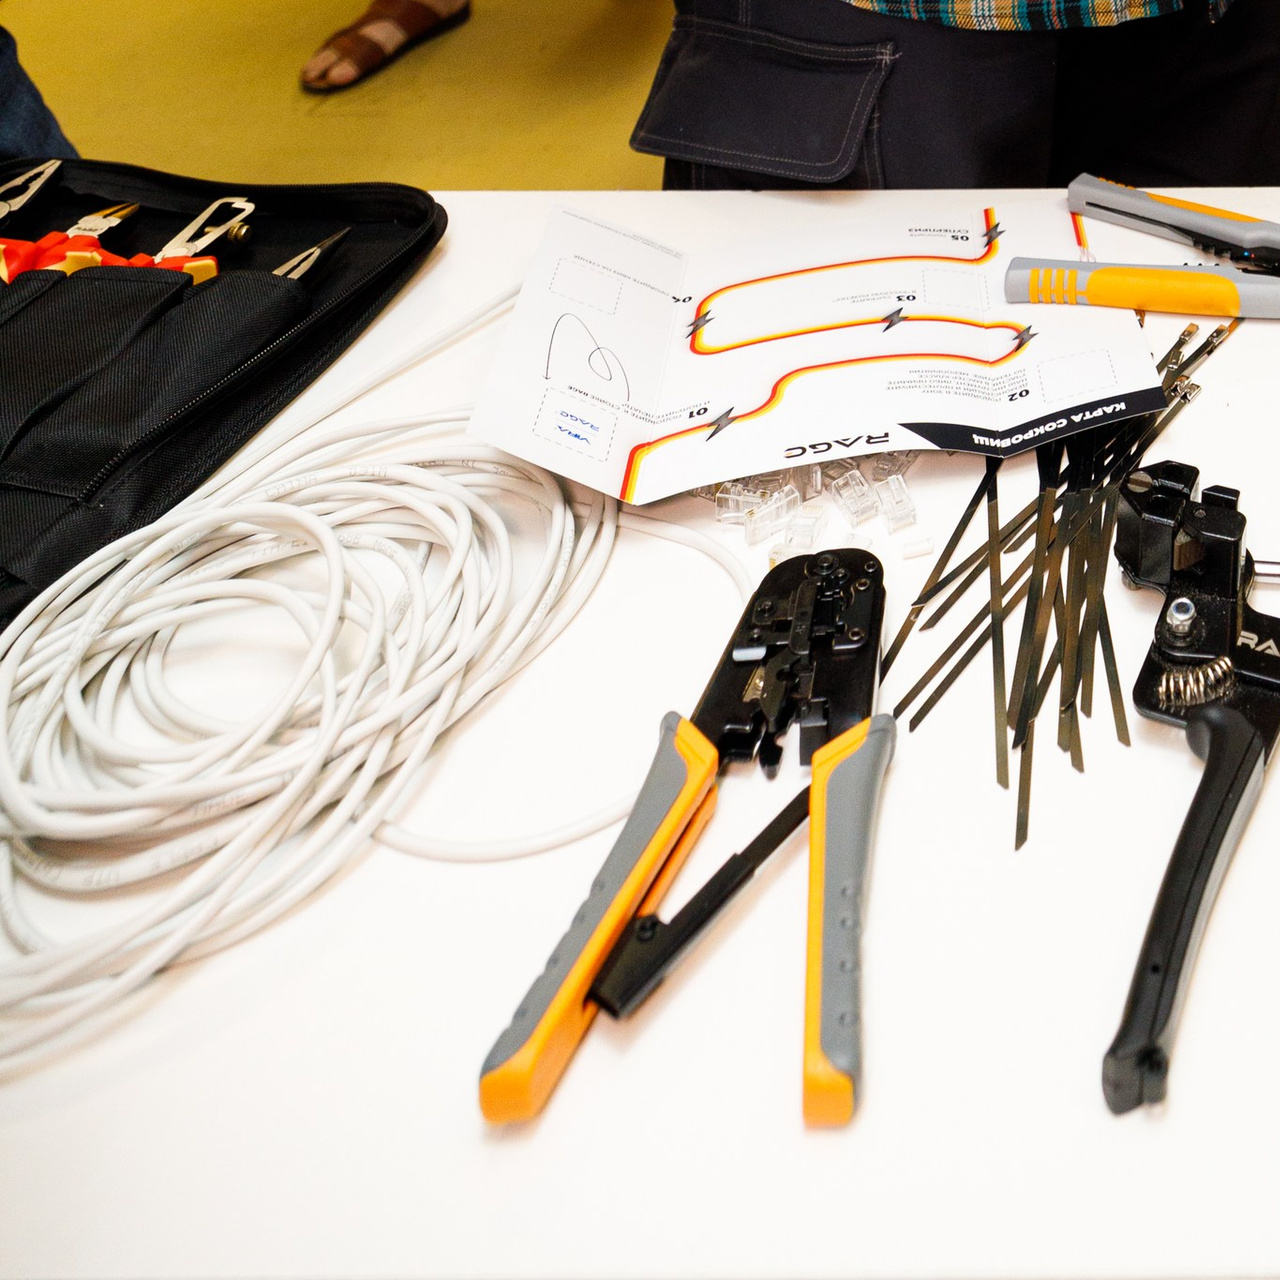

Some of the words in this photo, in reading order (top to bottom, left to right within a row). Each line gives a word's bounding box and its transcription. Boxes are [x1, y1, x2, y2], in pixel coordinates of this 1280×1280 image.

[1008, 389, 1030, 402] 02
[688, 407, 708, 419] 01
[1070, 402, 1127, 422] КАРТА
[972, 418, 1068, 448] СОКРОВИЩ
